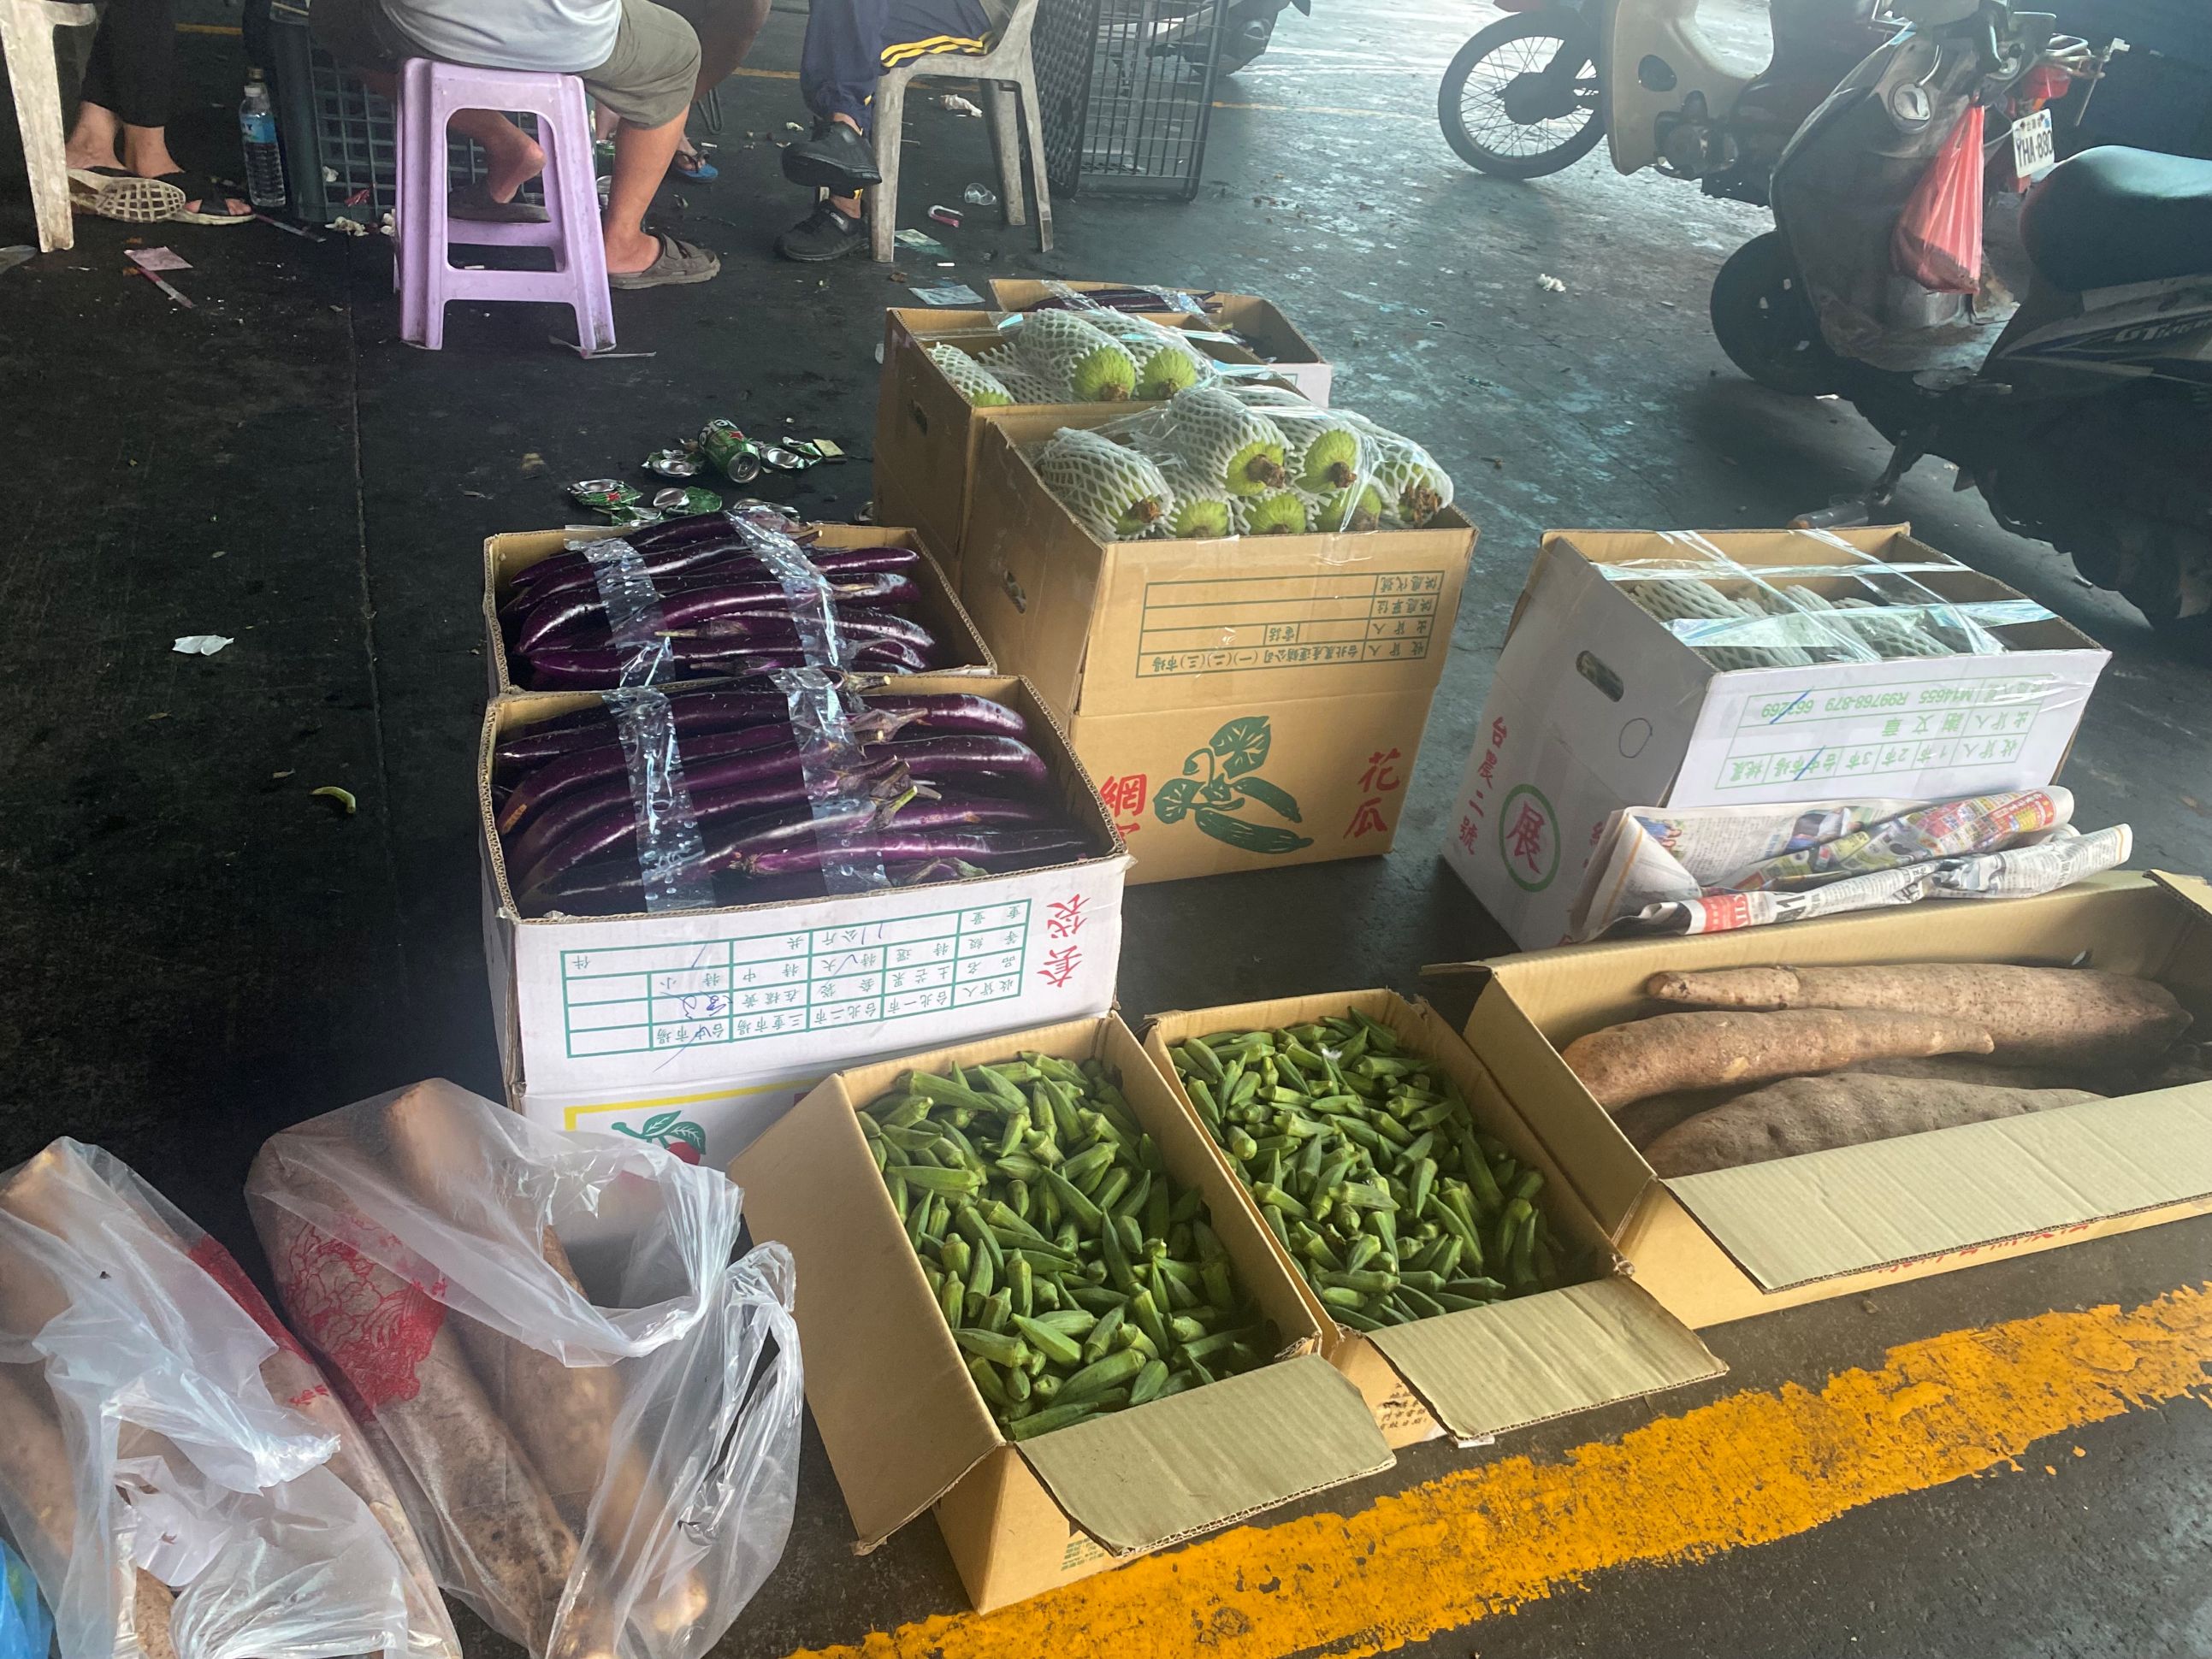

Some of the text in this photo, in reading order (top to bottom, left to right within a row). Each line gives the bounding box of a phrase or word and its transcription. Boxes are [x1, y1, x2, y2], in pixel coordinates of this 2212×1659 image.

[1377, 598, 1433, 614] 供應單位
[1269, 621, 1427, 642] 出貨人 電話
[1369, 641, 1423, 657] 收貨人
[1846, 750, 1872, 770] 3市
[1882, 747, 1909, 767] 2市
[1963, 739, 2019, 759] 收貨人
[1343, 747, 1401, 840] 花瓜
[1458, 717, 1507, 855] 台農二號
[1505, 800, 1546, 875] 展
[572, 906, 1020, 970] 重量 公斤 共 件
[1037, 894, 1091, 988] 套袋
[660, 930, 1020, 990] 等級 特選 特大 特中 特小
[968, 956, 1015, 975] 品名
[820, 977, 875, 999] 套袋
[892, 965, 949, 989] 土芒果
[657, 978, 1014, 1044] 收貨人 台北一市 台北二市 三重市場 台中市場
